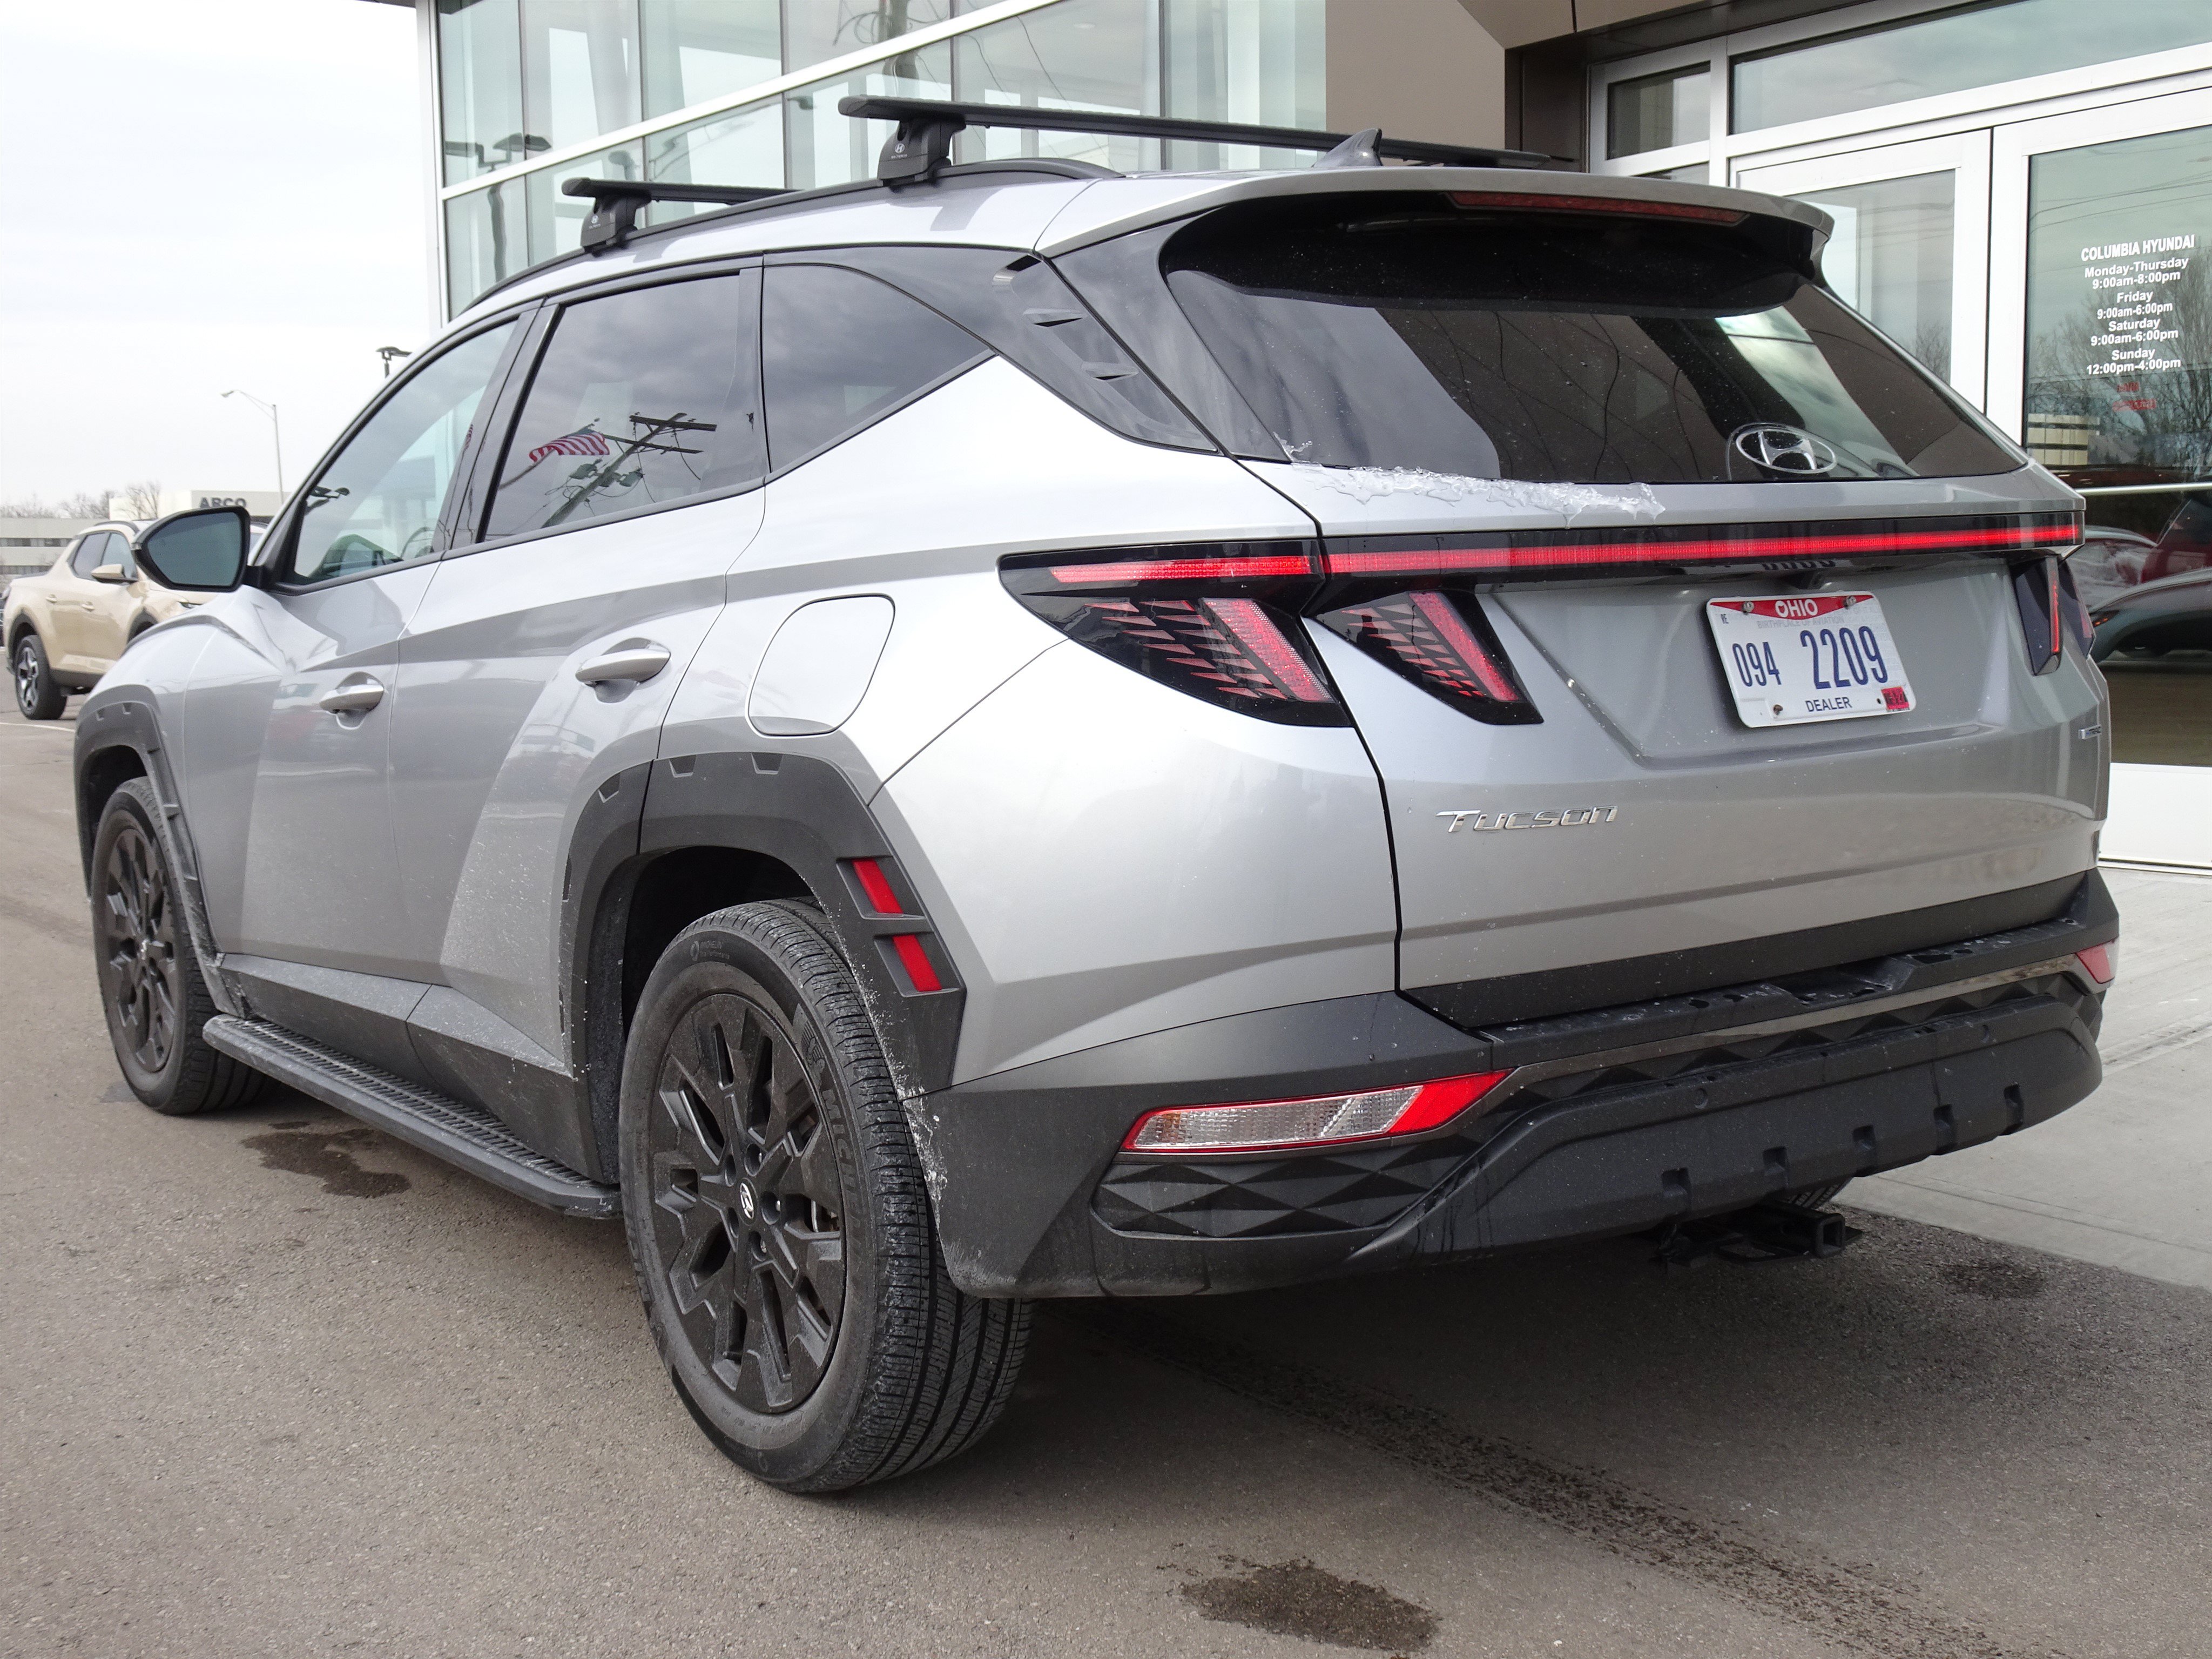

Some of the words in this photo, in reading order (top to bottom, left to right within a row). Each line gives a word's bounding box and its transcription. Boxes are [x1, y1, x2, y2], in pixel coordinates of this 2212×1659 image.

[2081, 242, 2140, 261] COLUMBIA
[2143, 234, 2195, 254] HYUNDAI
[2085, 257, 2189, 278] Monday-Thursday
[2092, 272, 2181, 289] 9:00am-8:00pm
[2117, 291, 2153, 303] Friday
[2097, 302, 2173, 320] 9:00am-6:00pm
[2108, 318, 2160, 332] Saturday
[2090, 330, 2179, 346] 9:00am-6:00pm
[2112, 348, 2155, 360] Sunday
[2086, 359, 2181, 375] 12:00pm-4:00pm
[1775, 599, 1818, 618] OHIO
[1732, 642, 1782, 687] 094
[1800, 626, 1888, 689] 2209
[1805, 697, 1852, 712] DEALER
